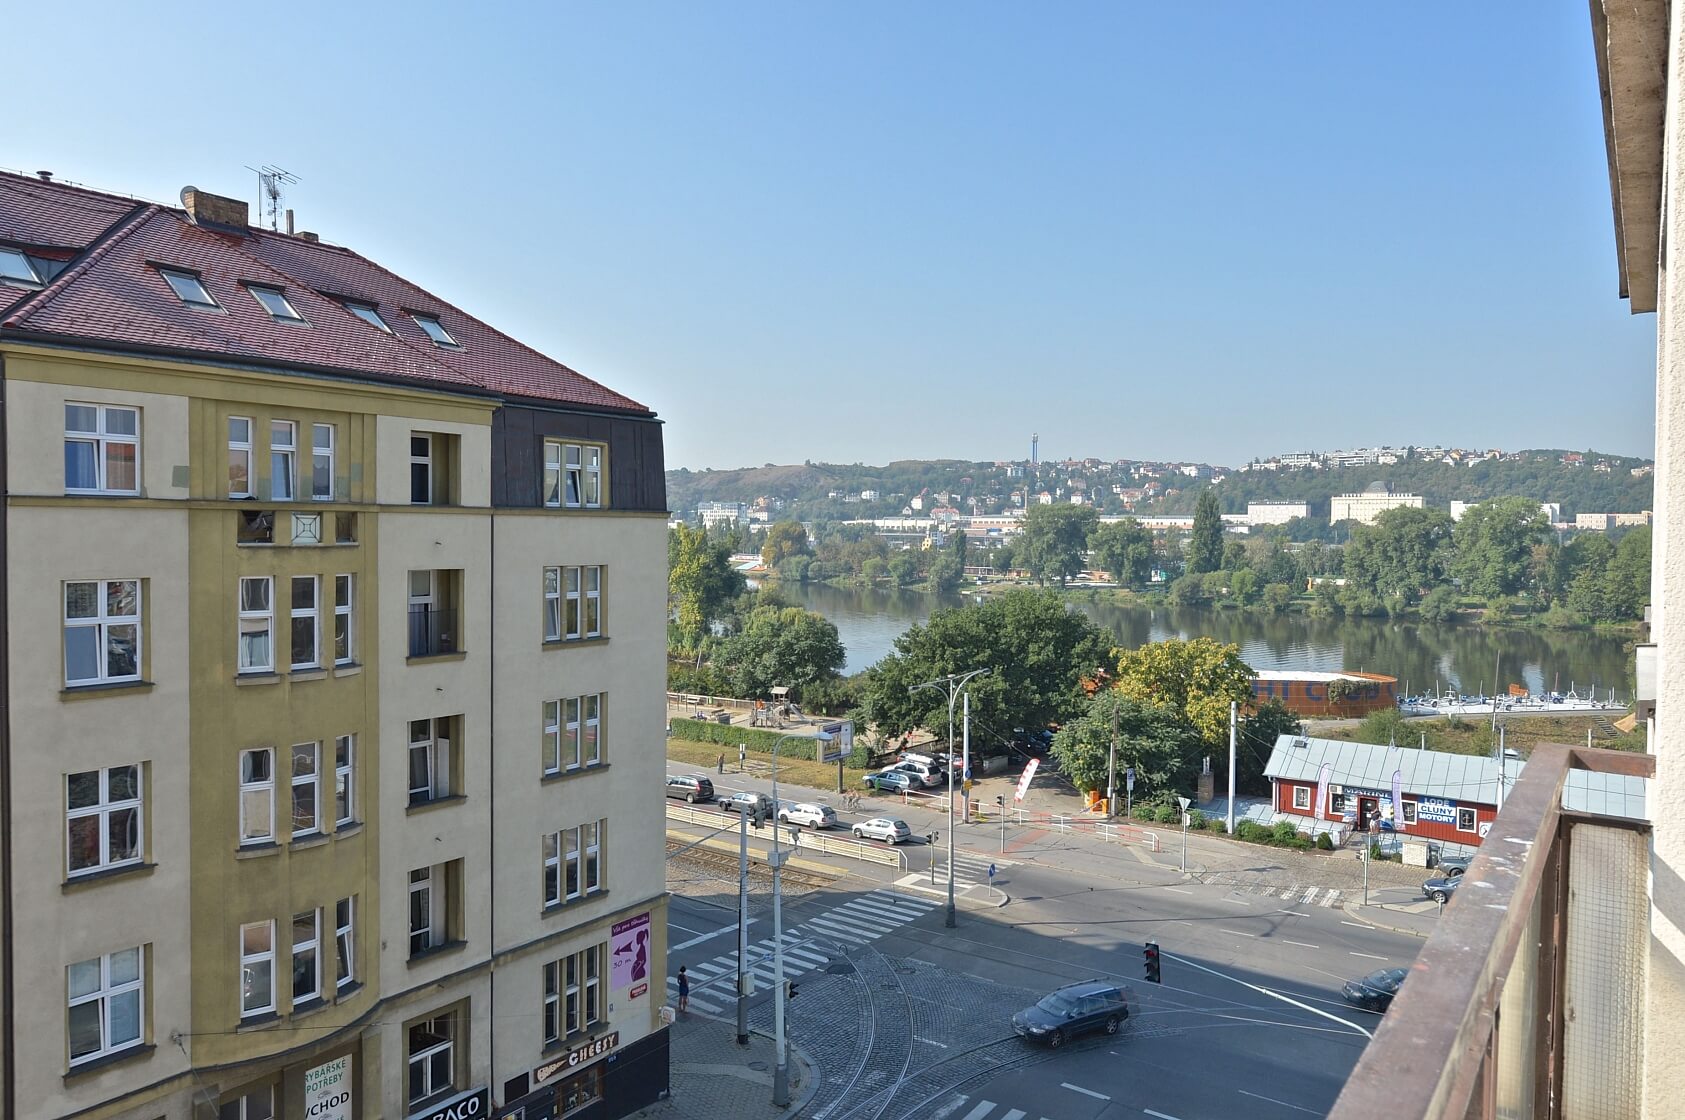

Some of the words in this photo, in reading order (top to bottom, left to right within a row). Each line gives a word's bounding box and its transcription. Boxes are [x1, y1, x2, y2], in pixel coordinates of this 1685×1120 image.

[1420, 805, 1453, 815] CLUNY
[1424, 797, 1450, 807] LODE
[1419, 813, 1454, 823] MOTORY
[568, 1034, 615, 1066] CHEESY
[305, 1057, 346, 1082] RYBÁŘSKÉ
[306, 1072, 343, 1094] POTŘEBY
